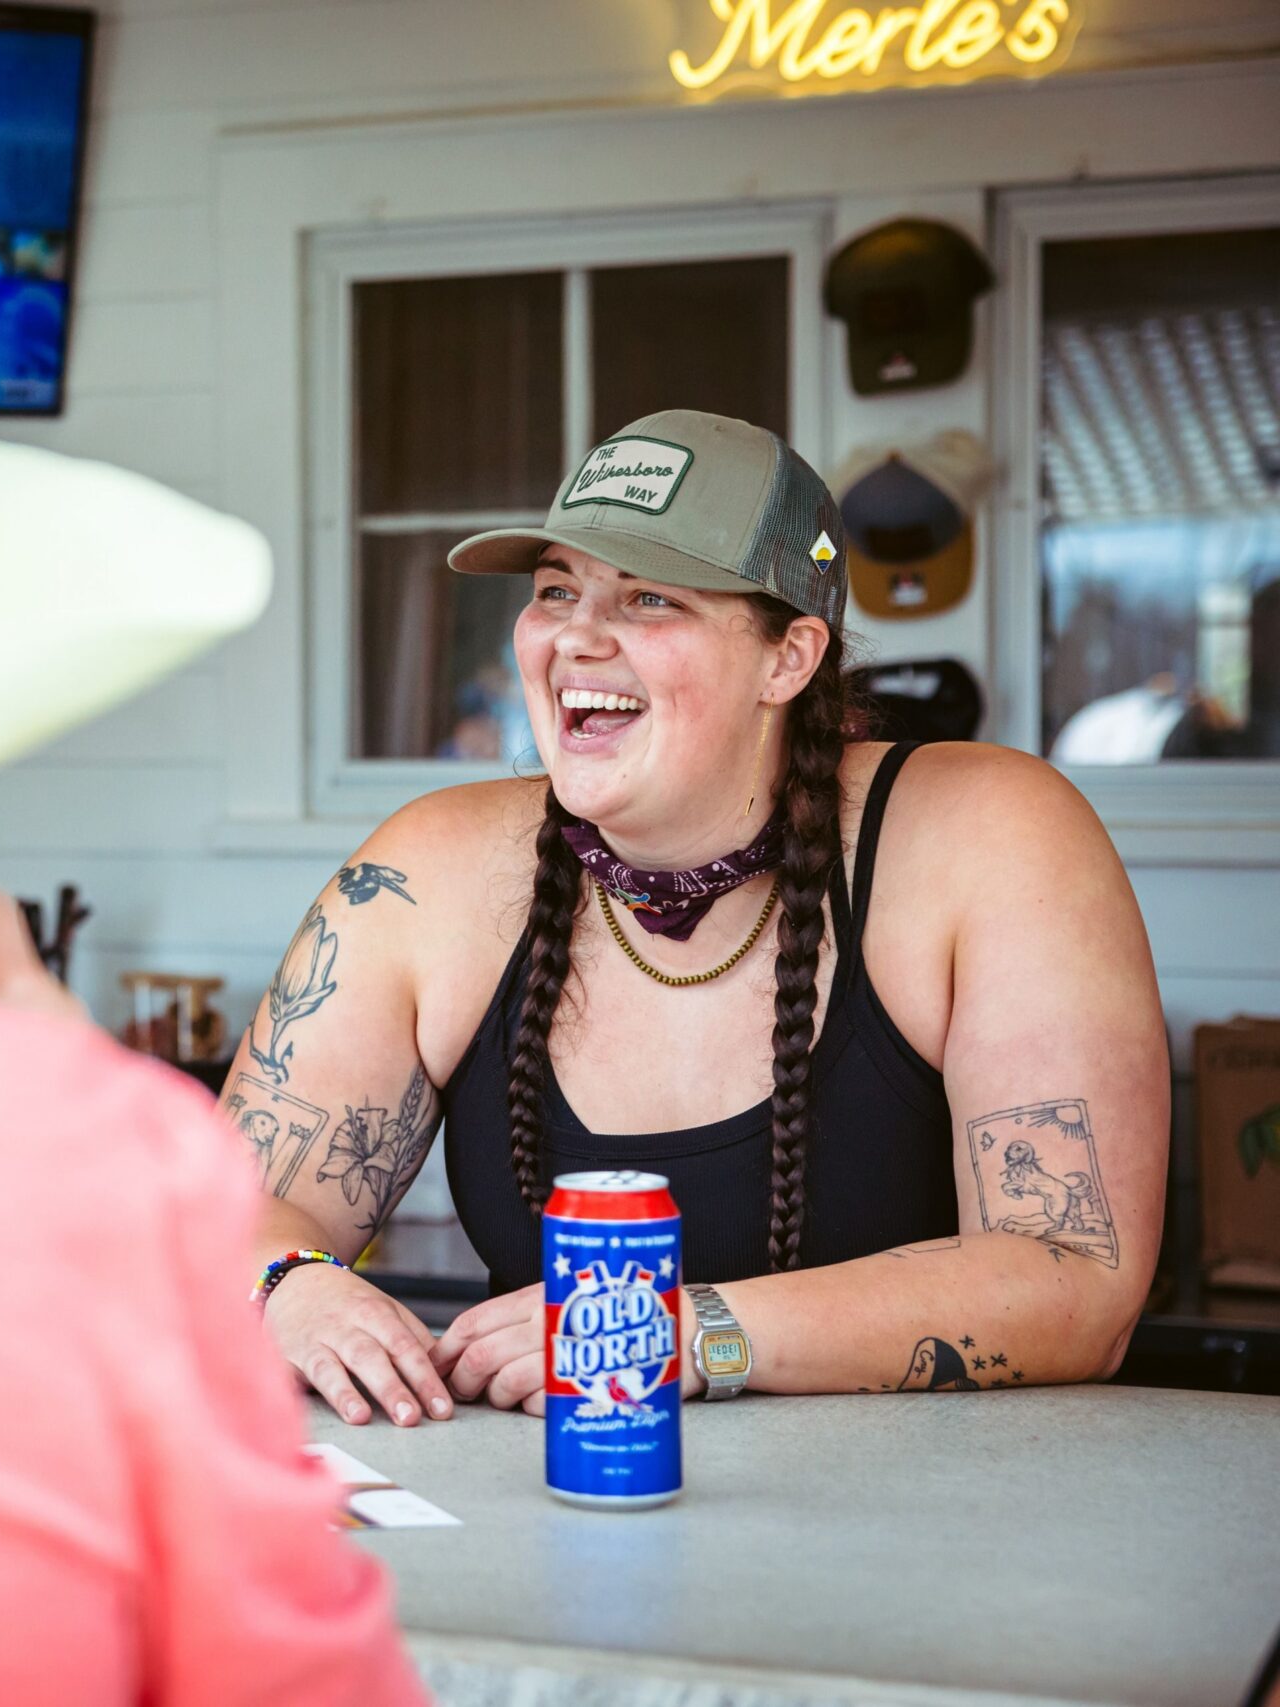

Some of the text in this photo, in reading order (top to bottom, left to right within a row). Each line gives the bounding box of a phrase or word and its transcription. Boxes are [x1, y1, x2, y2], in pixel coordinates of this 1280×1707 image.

[668, 0, 1068, 88] Merles
[596, 446, 618, 461] THE
[577, 462, 673, 493] Wilkesboro
[624, 485, 658, 503] WAY
[570, 1289, 654, 1337] OLD
[554, 1318, 674, 1377] NORTH
